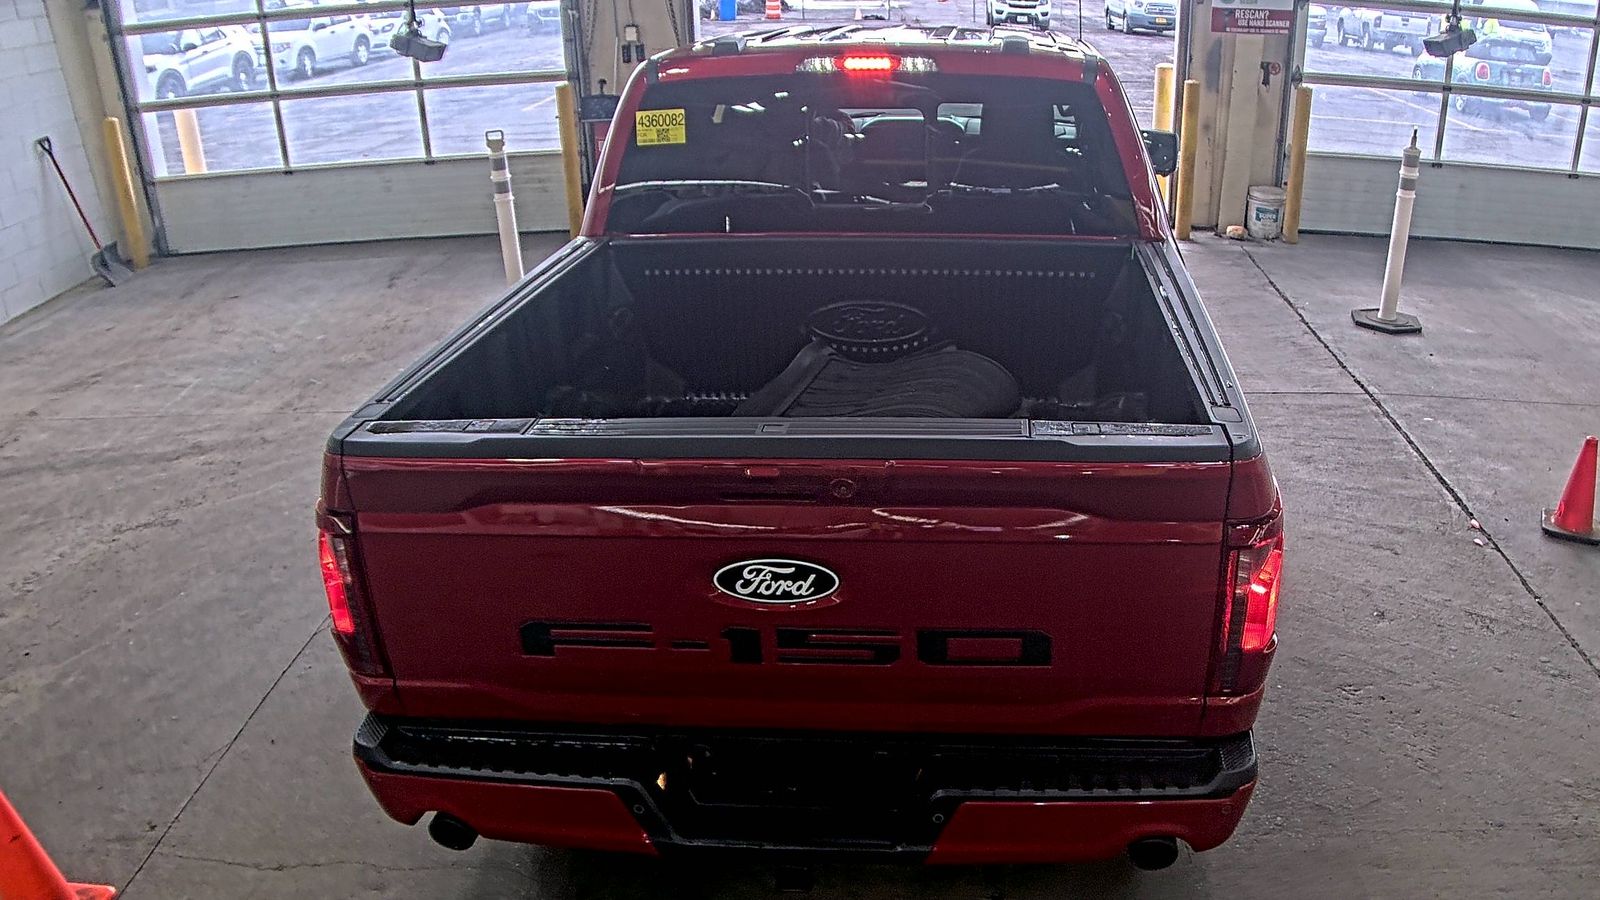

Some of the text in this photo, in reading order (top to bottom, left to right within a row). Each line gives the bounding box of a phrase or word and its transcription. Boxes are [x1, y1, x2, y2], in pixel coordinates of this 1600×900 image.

[1235, 9, 1270, 19] RESCAN?
[1249, 19, 1264, 27] HAND
[1265, 20, 1290, 28] SCANNER
[638, 113, 684, 127] 4360082
[735, 565, 816, 595] Ford
[519, 621, 1053, 667] F-150
